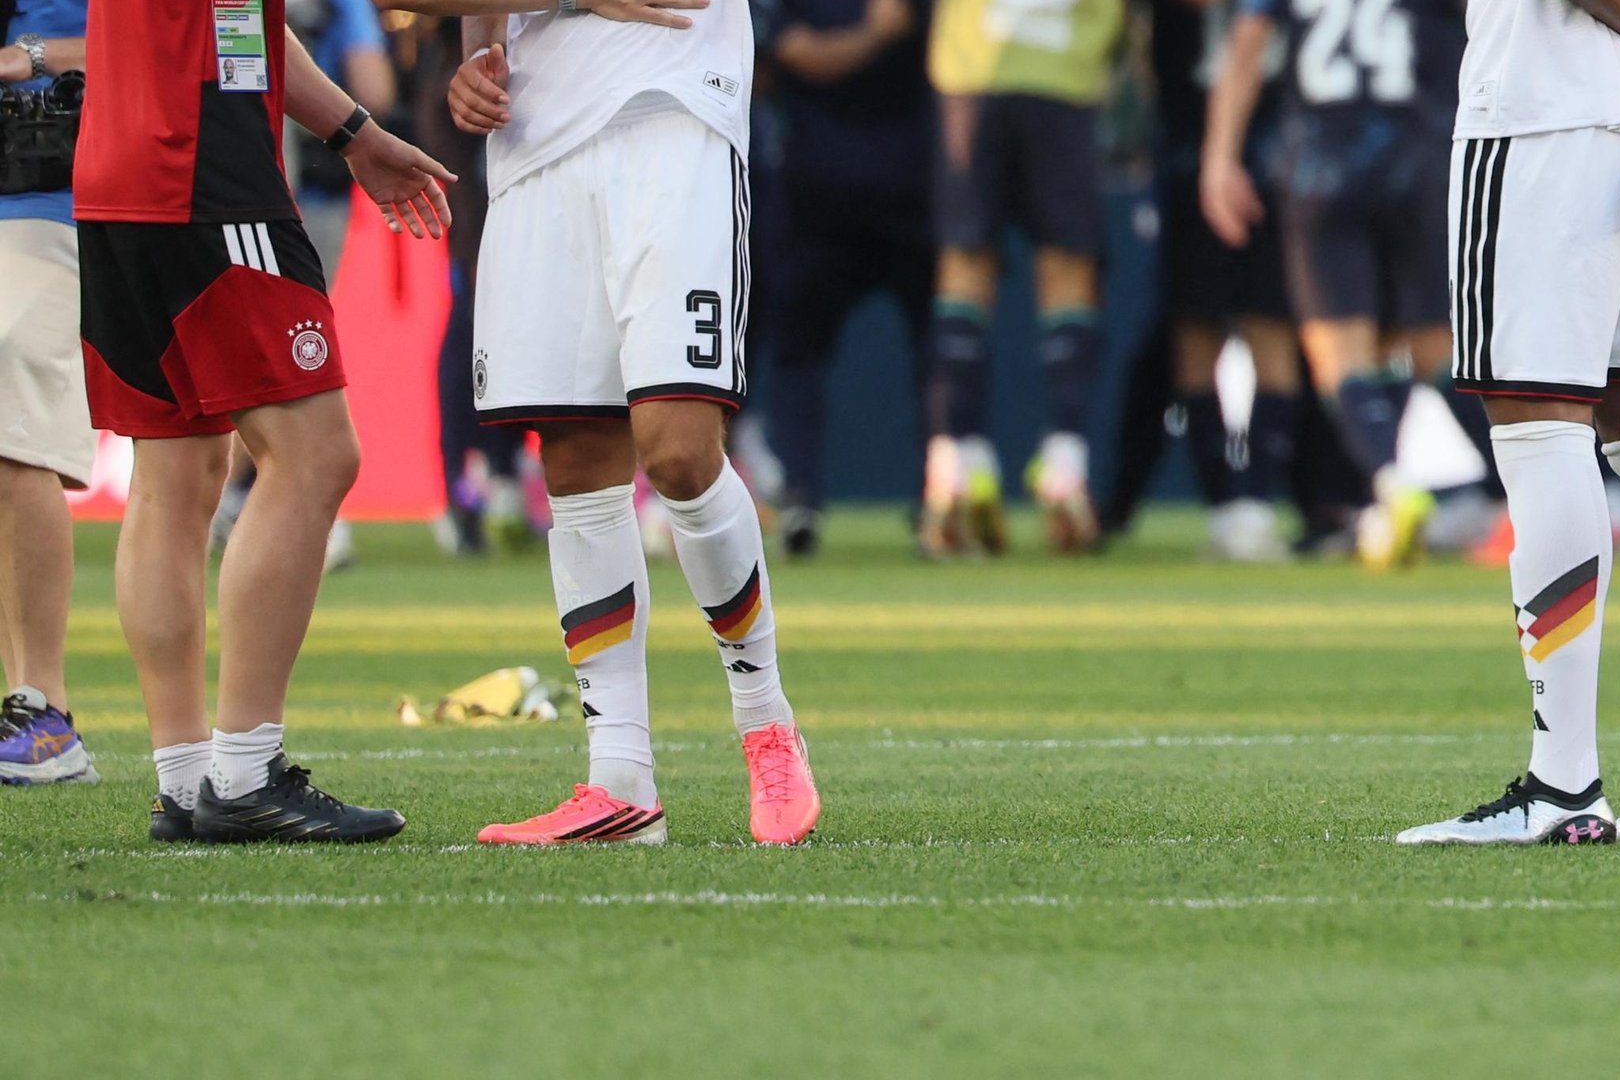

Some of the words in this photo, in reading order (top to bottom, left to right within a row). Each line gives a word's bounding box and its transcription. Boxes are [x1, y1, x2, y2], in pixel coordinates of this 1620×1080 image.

[686, 289, 723, 370] 3
[576, 678, 590, 691] FB
[1529, 679, 1545, 695] FB
